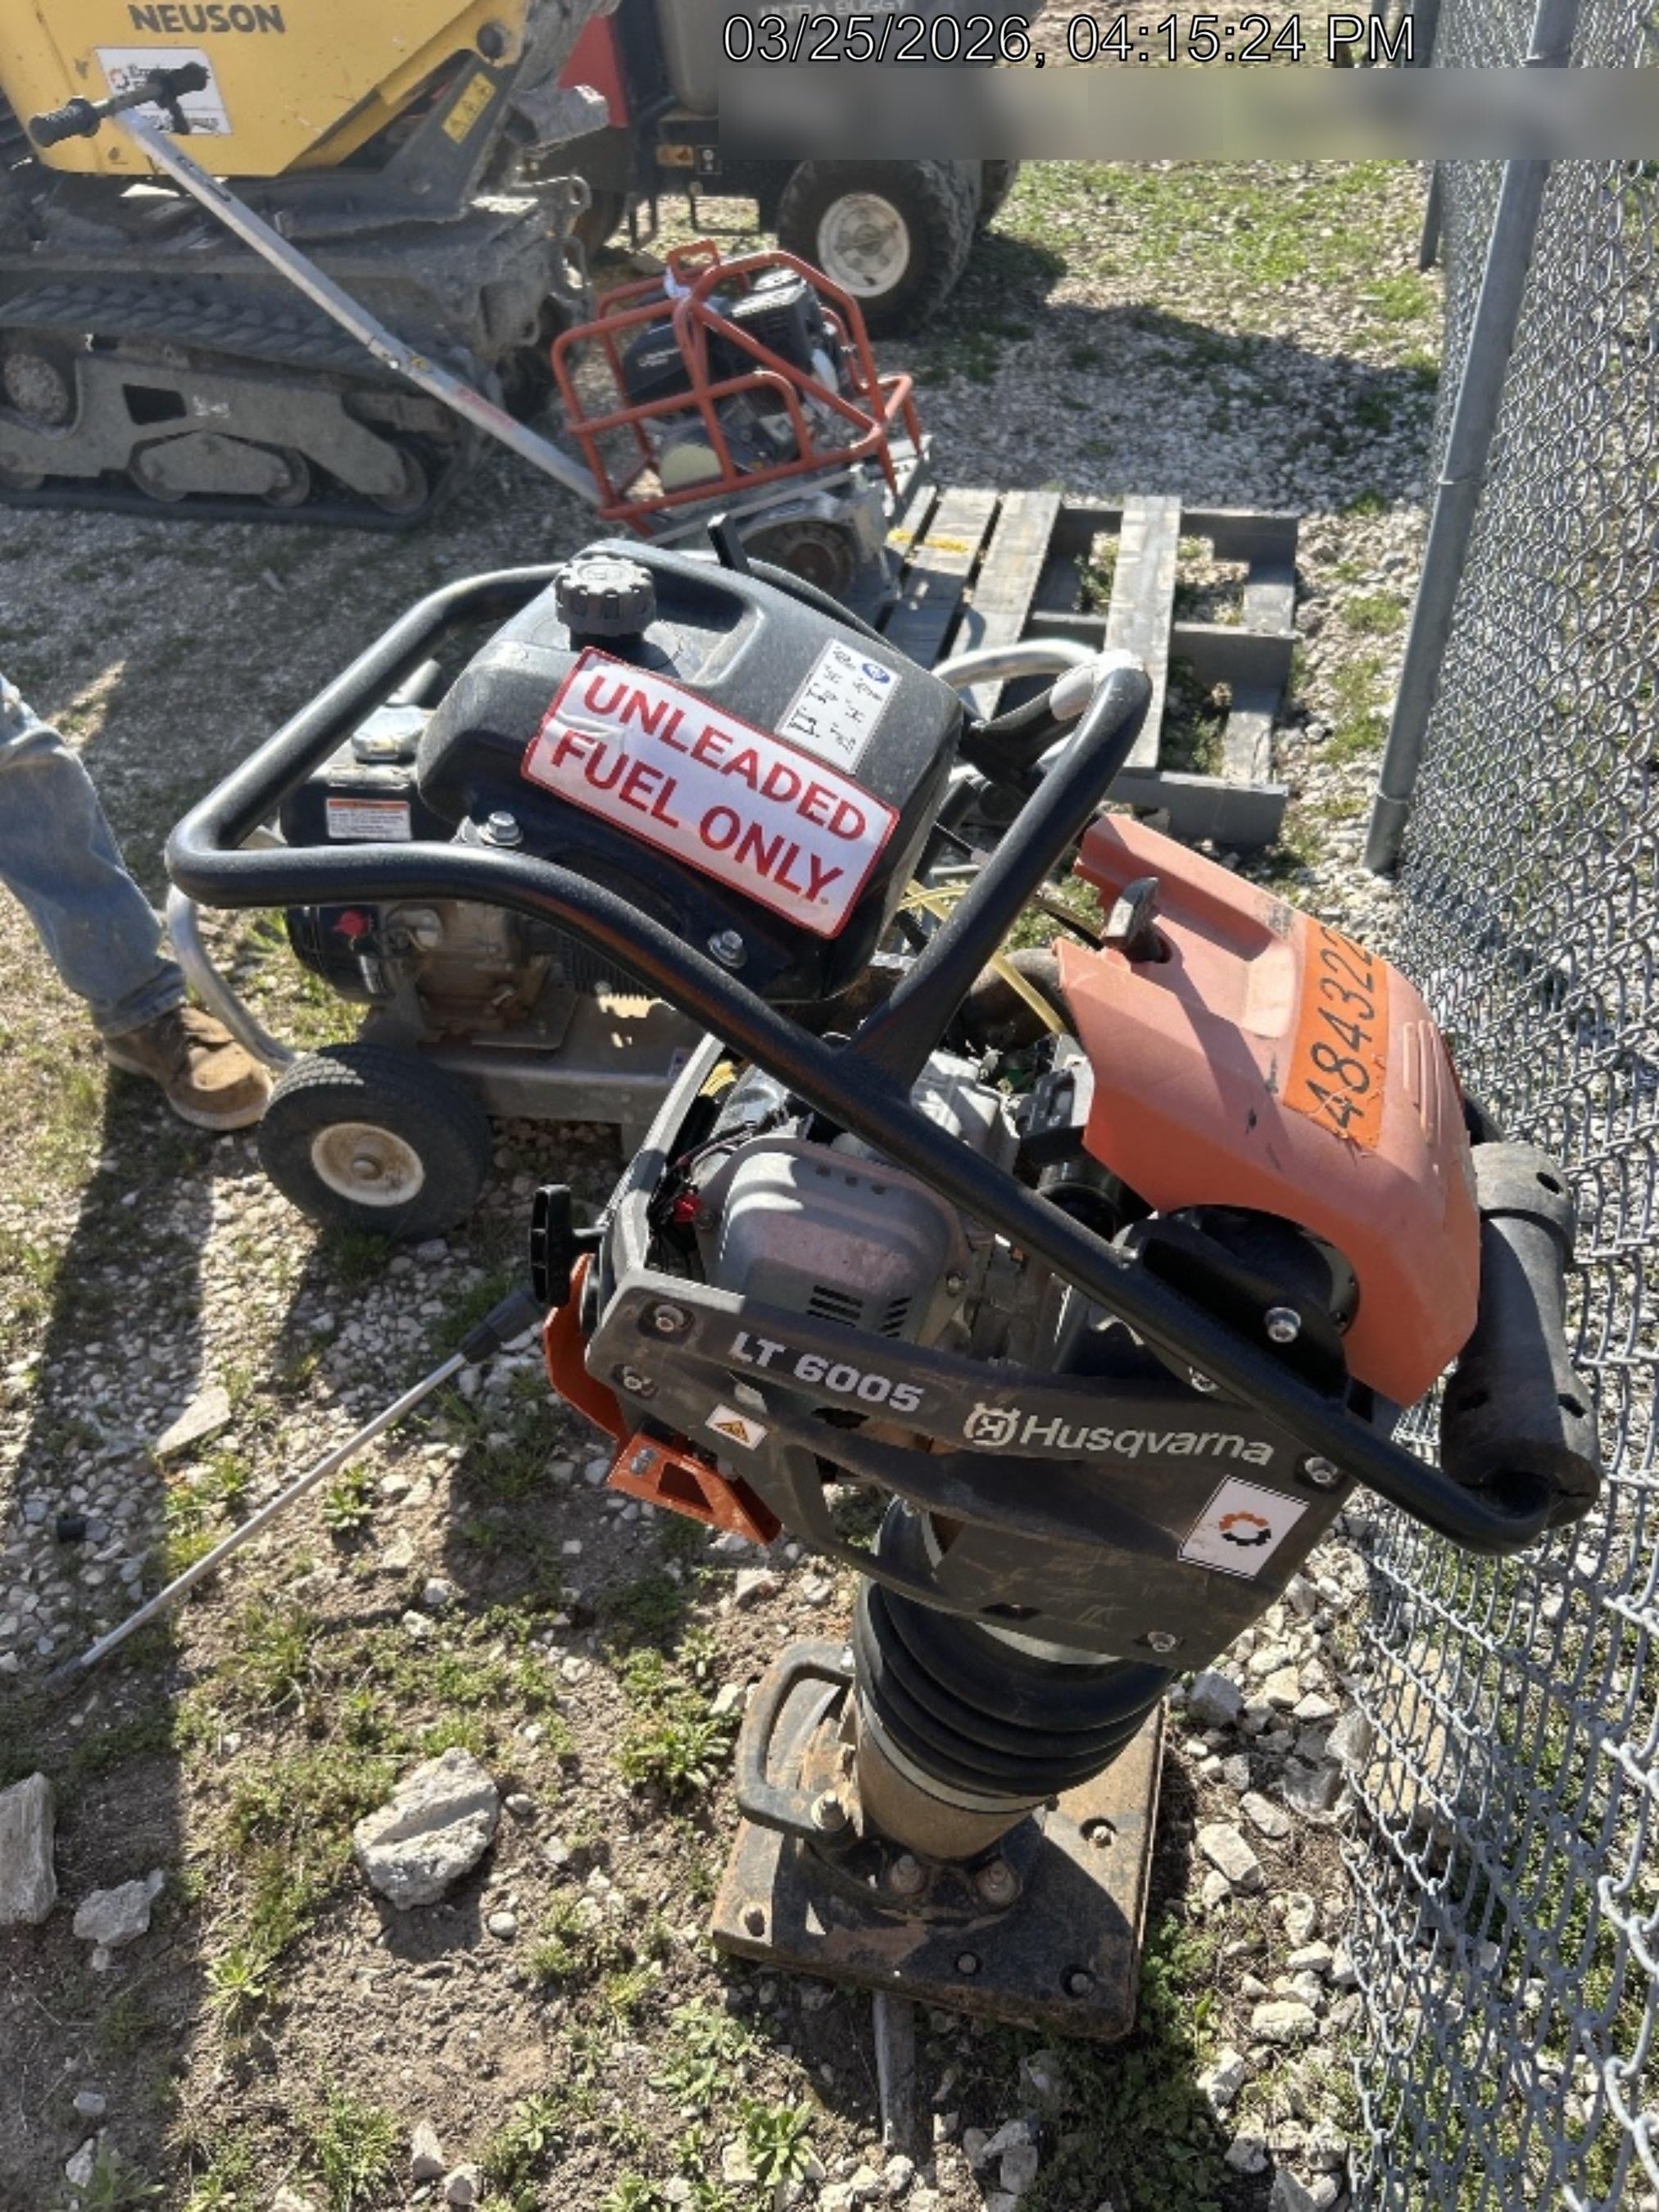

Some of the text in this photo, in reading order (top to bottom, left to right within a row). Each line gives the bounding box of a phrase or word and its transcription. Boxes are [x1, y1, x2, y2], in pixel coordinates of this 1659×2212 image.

[128, 4, 286, 34] NEUSON
[583, 675, 867, 841] UNLEADED
[551, 729, 844, 903] FUEL ONLY
[728, 1331, 924, 1412] LT 6005
[1019, 1414, 1275, 1466] Husqvarna
